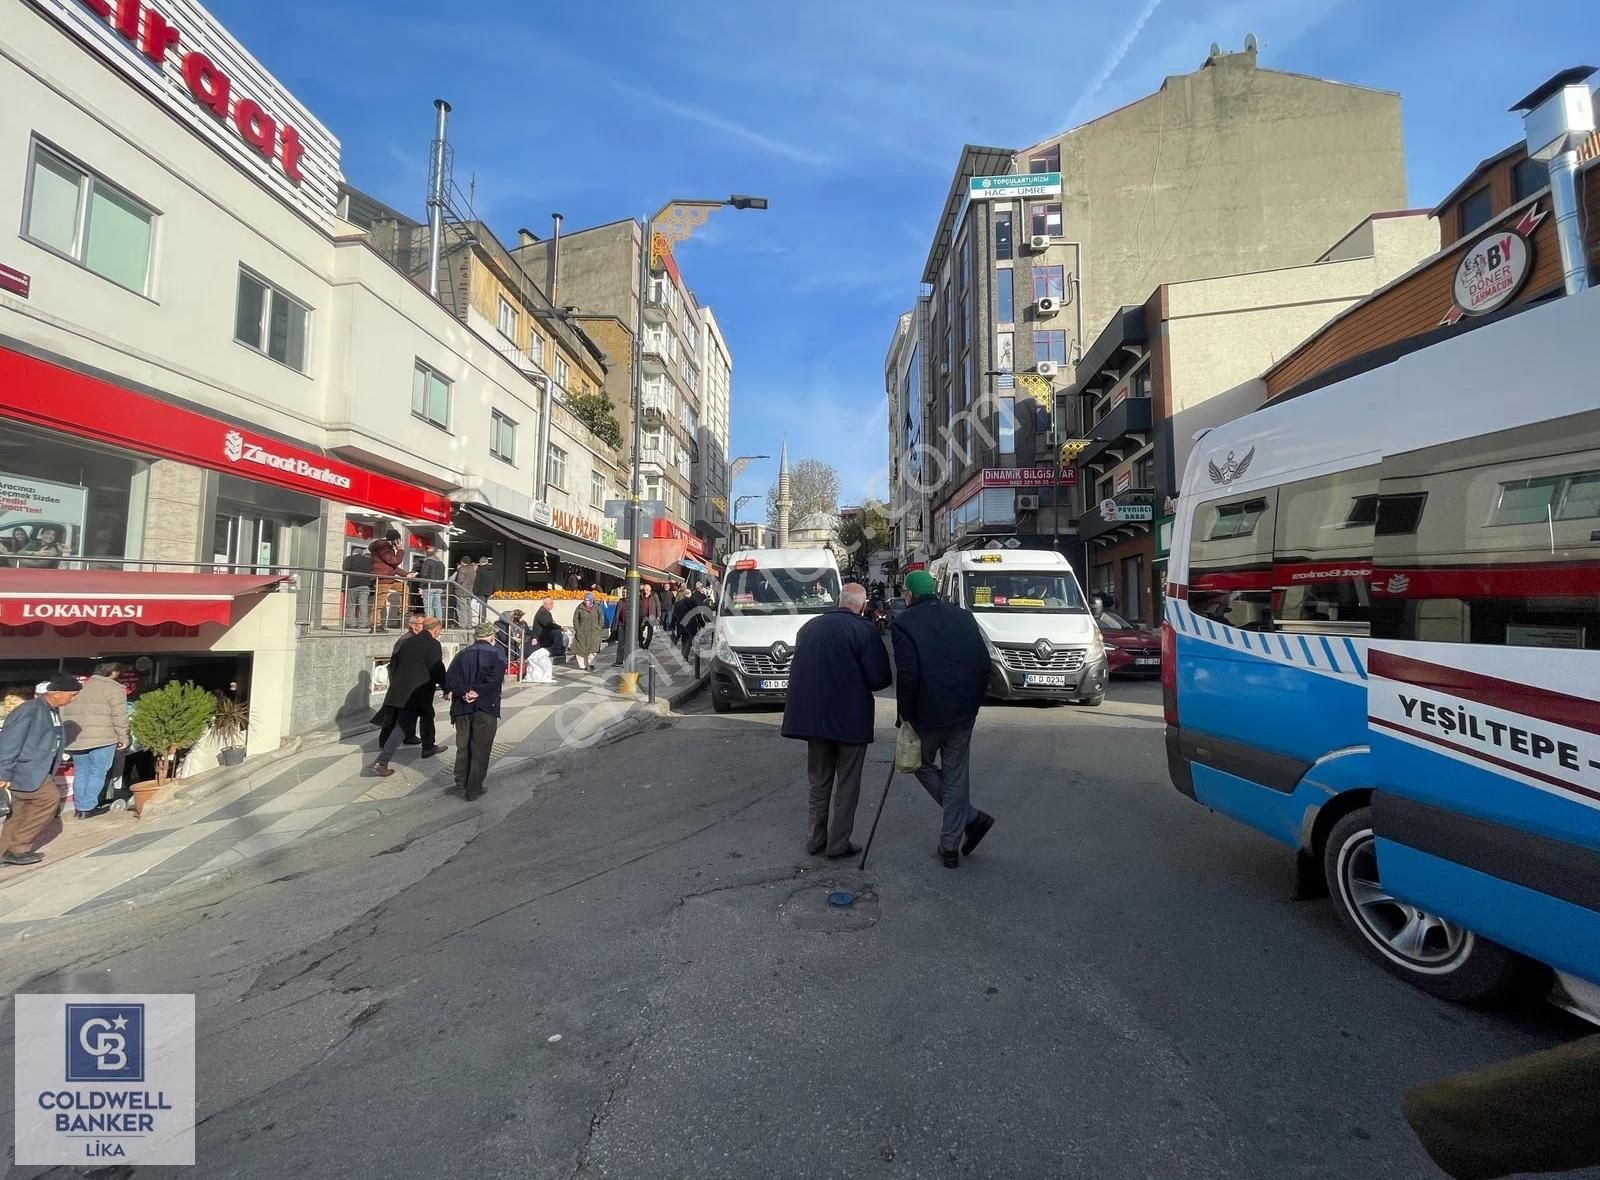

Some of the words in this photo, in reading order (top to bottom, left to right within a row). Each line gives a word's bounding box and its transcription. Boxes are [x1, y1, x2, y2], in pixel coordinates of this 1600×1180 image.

[985, 189, 1006, 197] HAC
[1017, 187, 1047, 195] UMRE
[1487, 235, 1512, 271] BY
[242, 445, 298, 475] Ziraat
[552, 507, 574, 534] HALK
[23, 604, 144, 618] LOKANTASI
[1398, 694, 1580, 771] YEŞİLTEPE
